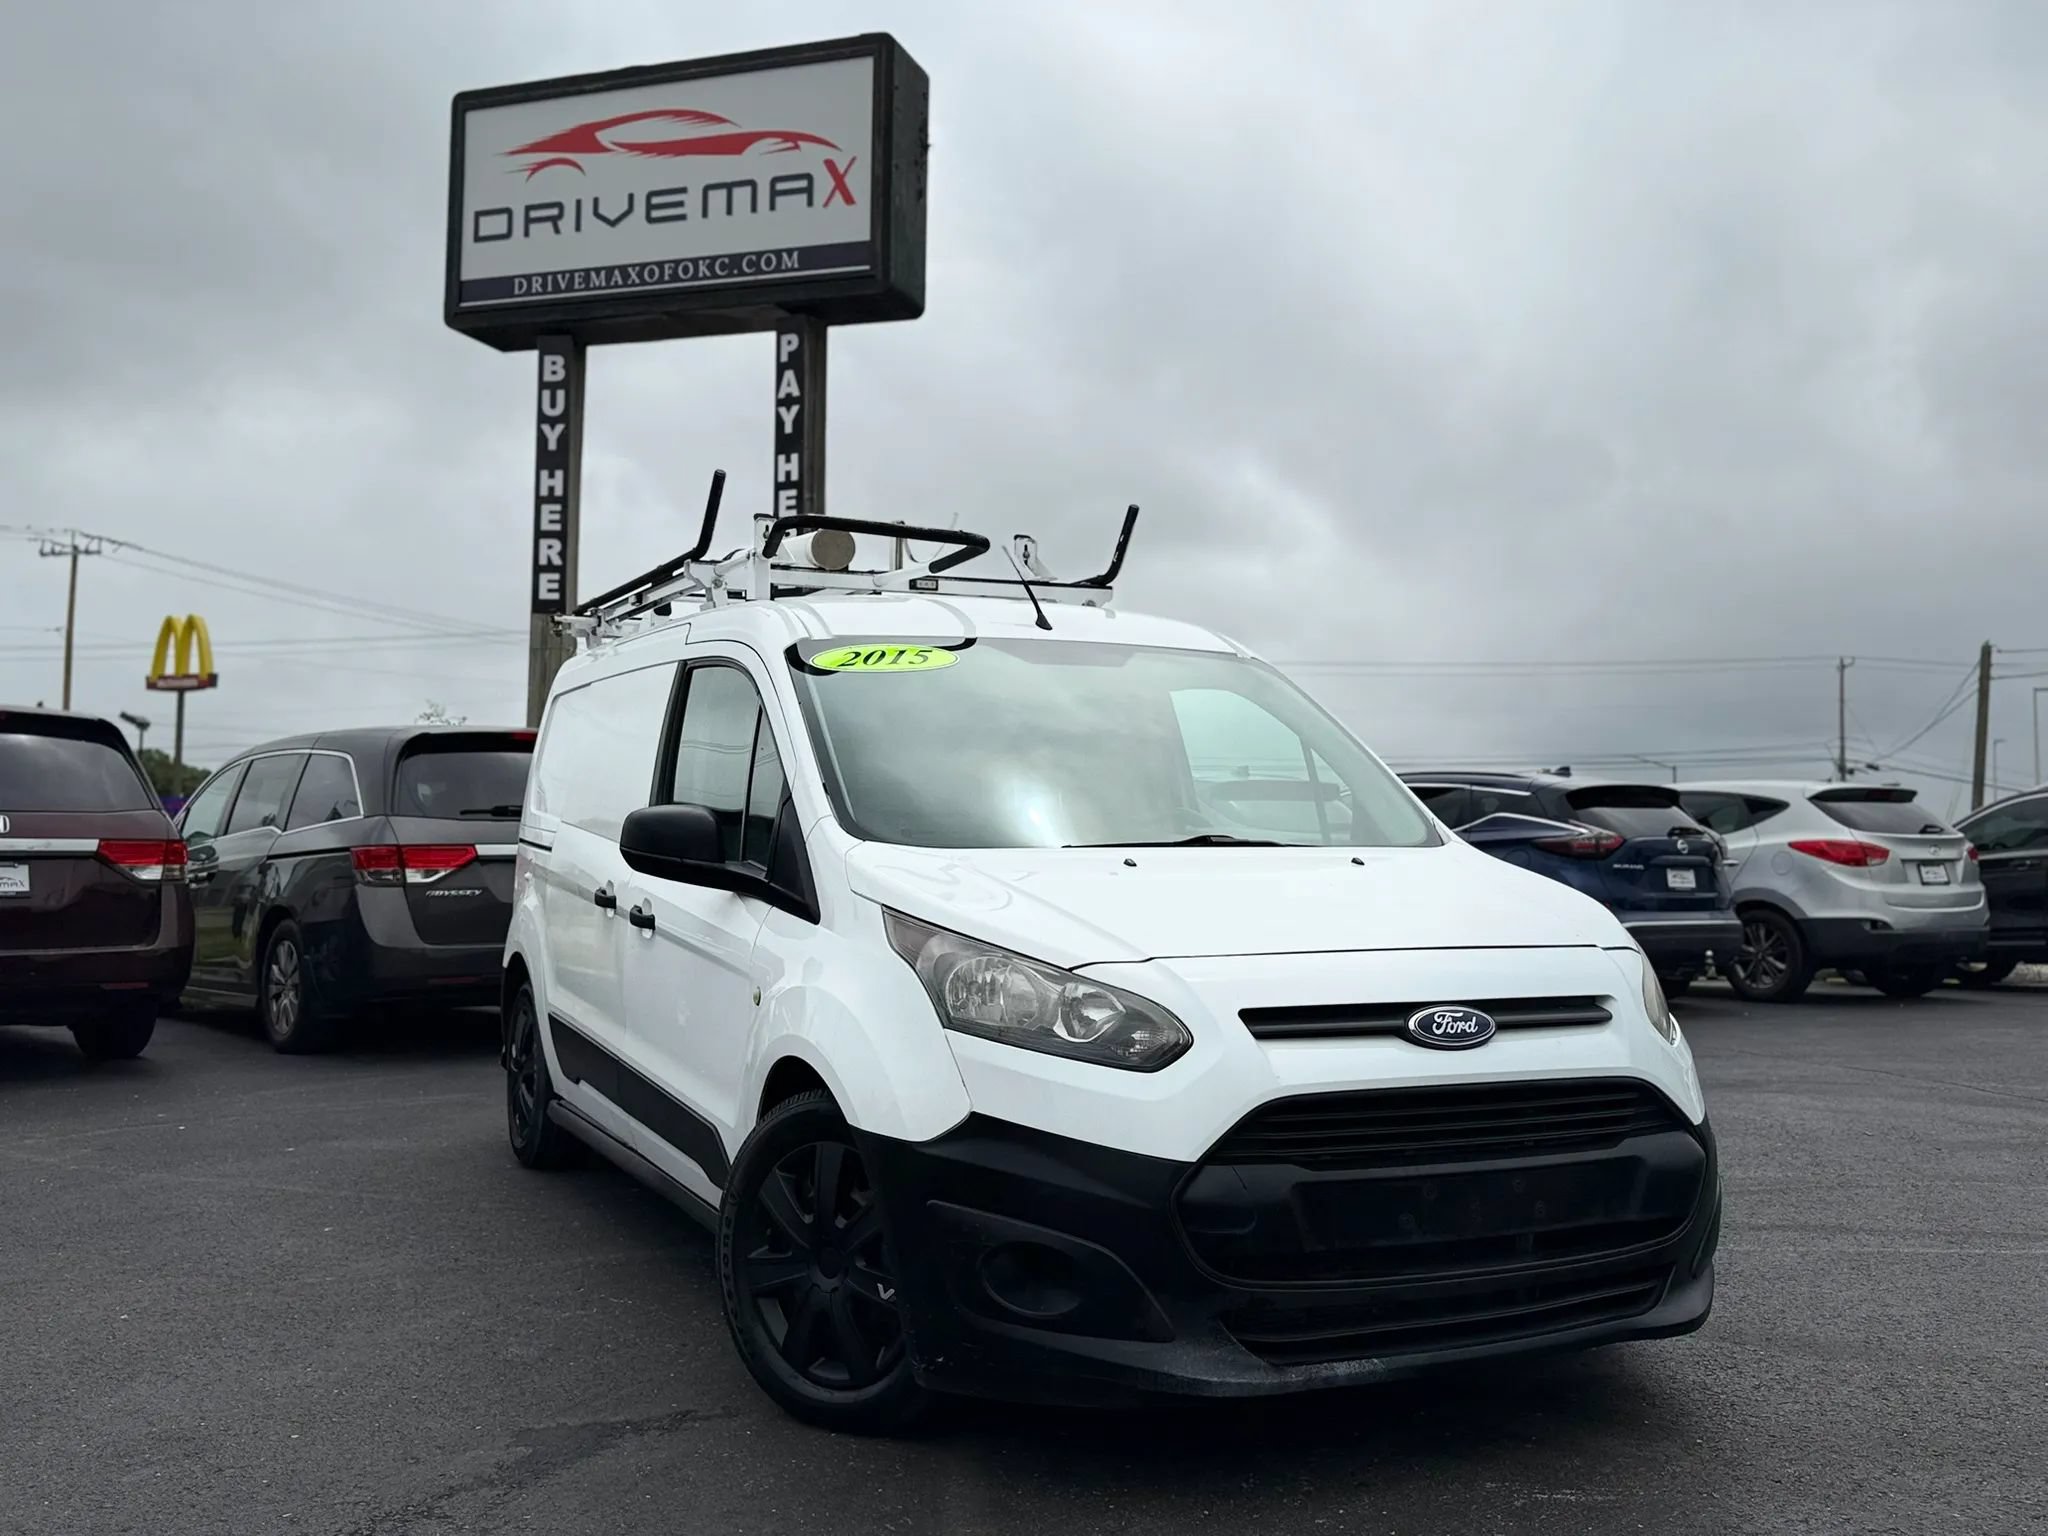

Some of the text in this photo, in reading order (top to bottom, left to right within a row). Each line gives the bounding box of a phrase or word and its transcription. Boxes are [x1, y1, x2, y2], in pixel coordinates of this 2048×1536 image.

[512, 250, 801, 296] DRIVEMAXOFOKC.COM
[777, 333, 800, 435] PAY
[538, 354, 566, 601] BUY HERE
[837, 649, 933, 667] 2015
[1432, 1011, 1479, 1035] Ford
